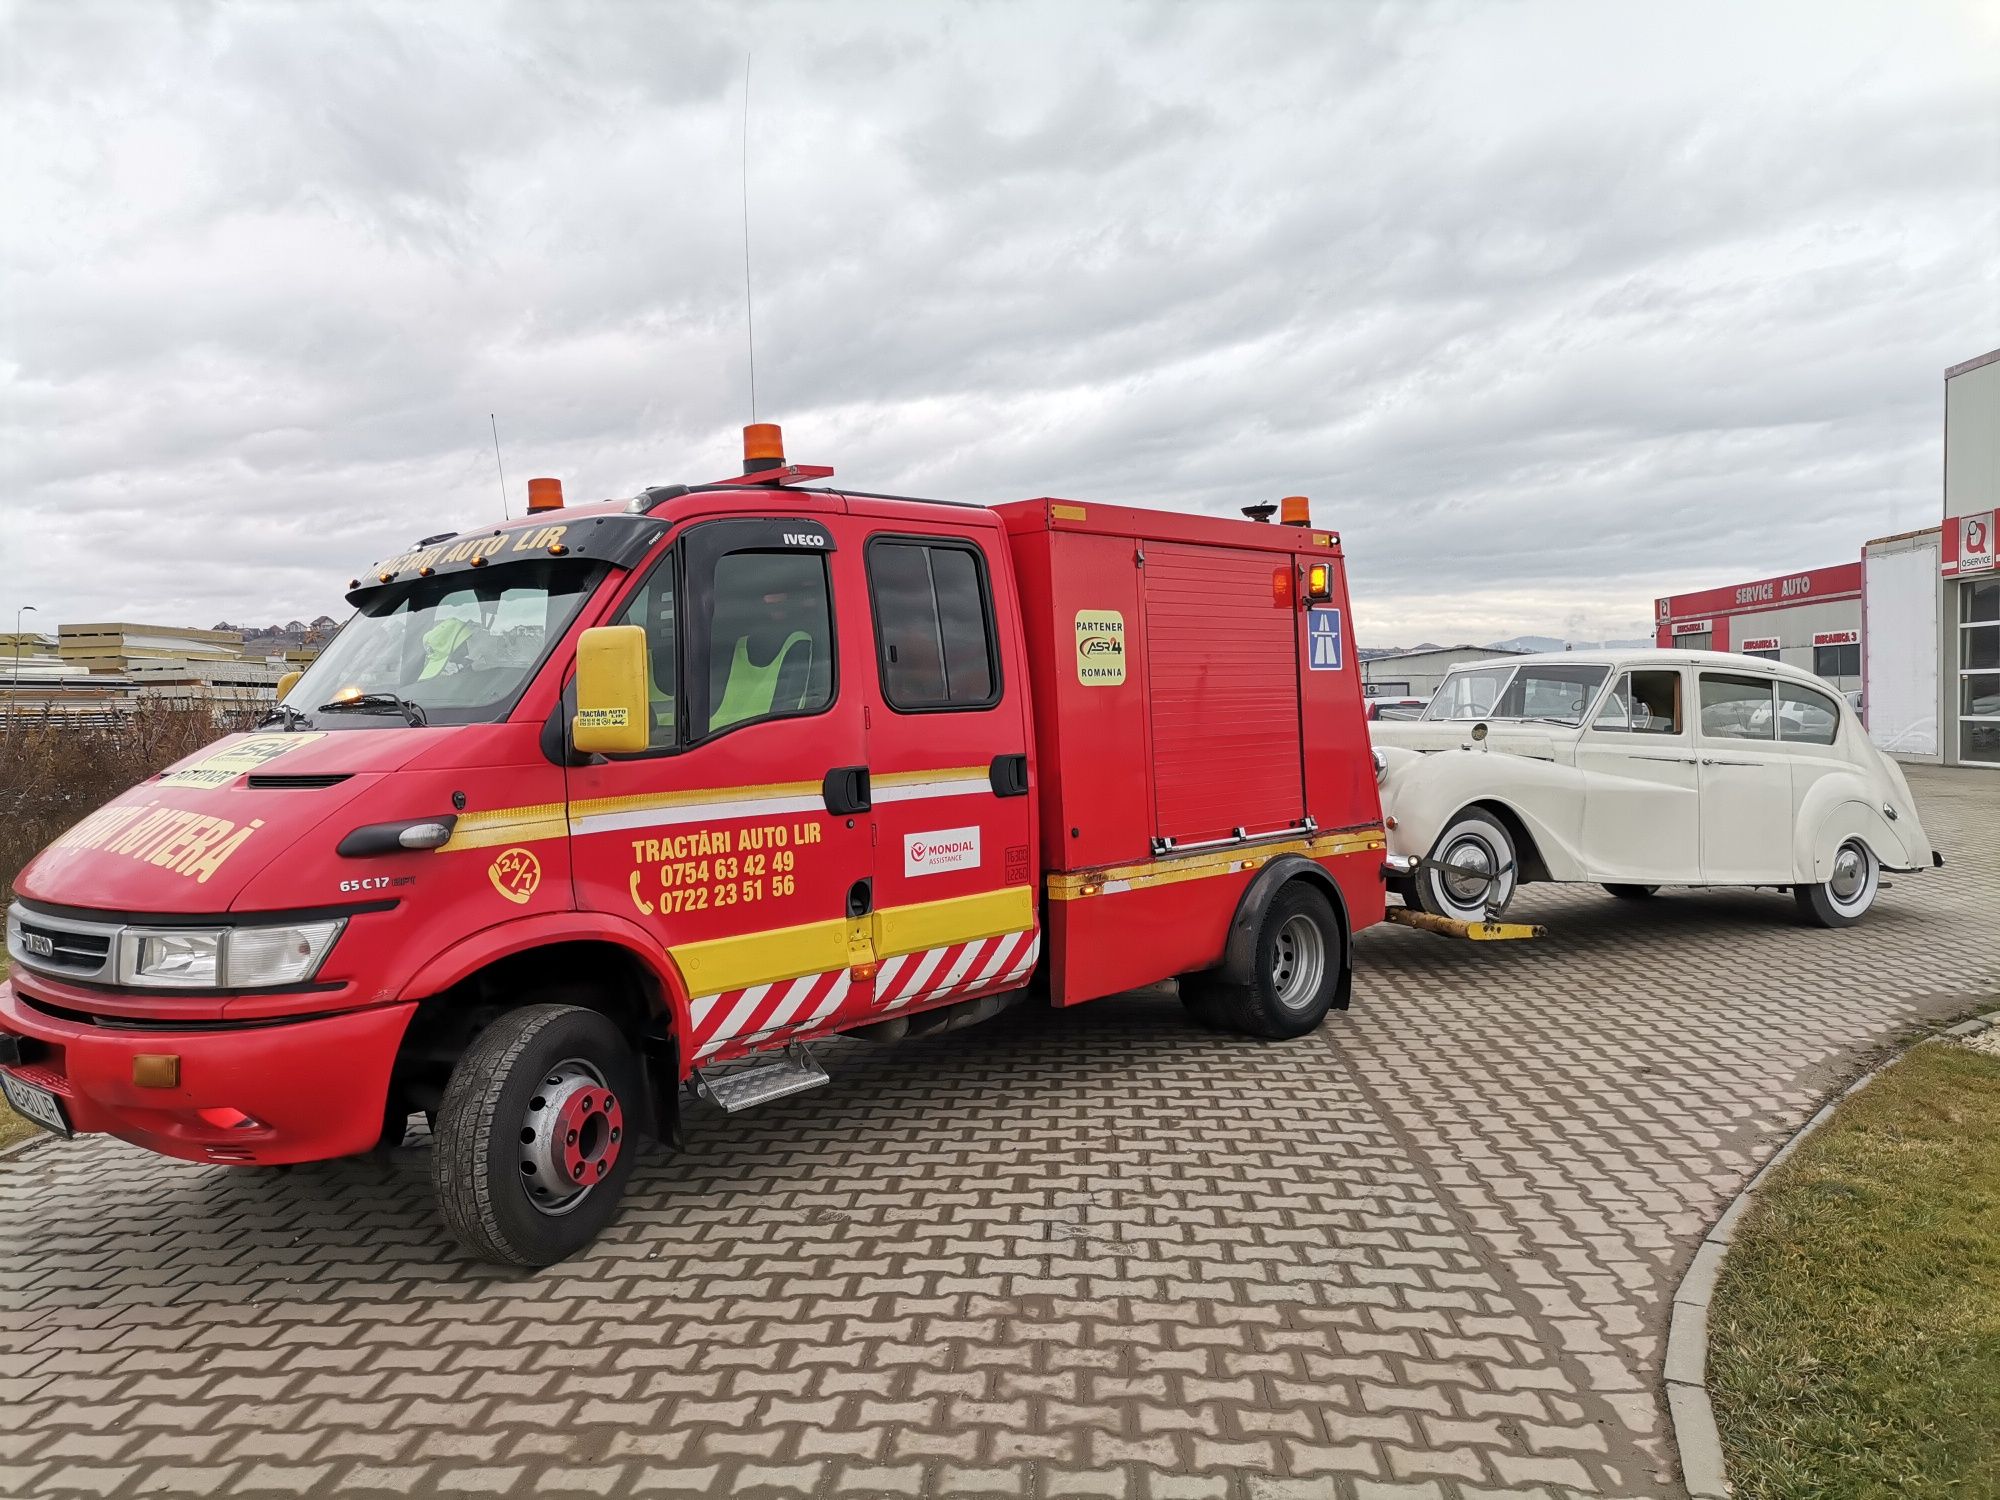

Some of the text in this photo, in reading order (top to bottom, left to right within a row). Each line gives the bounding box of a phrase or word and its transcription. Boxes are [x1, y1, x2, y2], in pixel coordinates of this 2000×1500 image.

[440, 534, 510, 564] AUTO
[512, 525, 569, 552] LIR
[783, 533, 824, 546] IVECO
[1736, 576, 1811, 604] SERVICE AUTO
[1076, 622, 1123, 631] PARTENER
[1773, 639, 1779, 648] 2
[1851, 632, 1857, 642] 3
[1081, 668, 1122, 677] ROMANIA
[738, 826, 787, 850] AUTO
[793, 822, 821, 845] LIR
[928, 841, 974, 856] MONDIAL
[929, 855, 962, 866] ASSISTANCE
[661, 851, 794, 887] 0754 63 42 49
[660, 875, 794, 914] 0722 23 51 56
